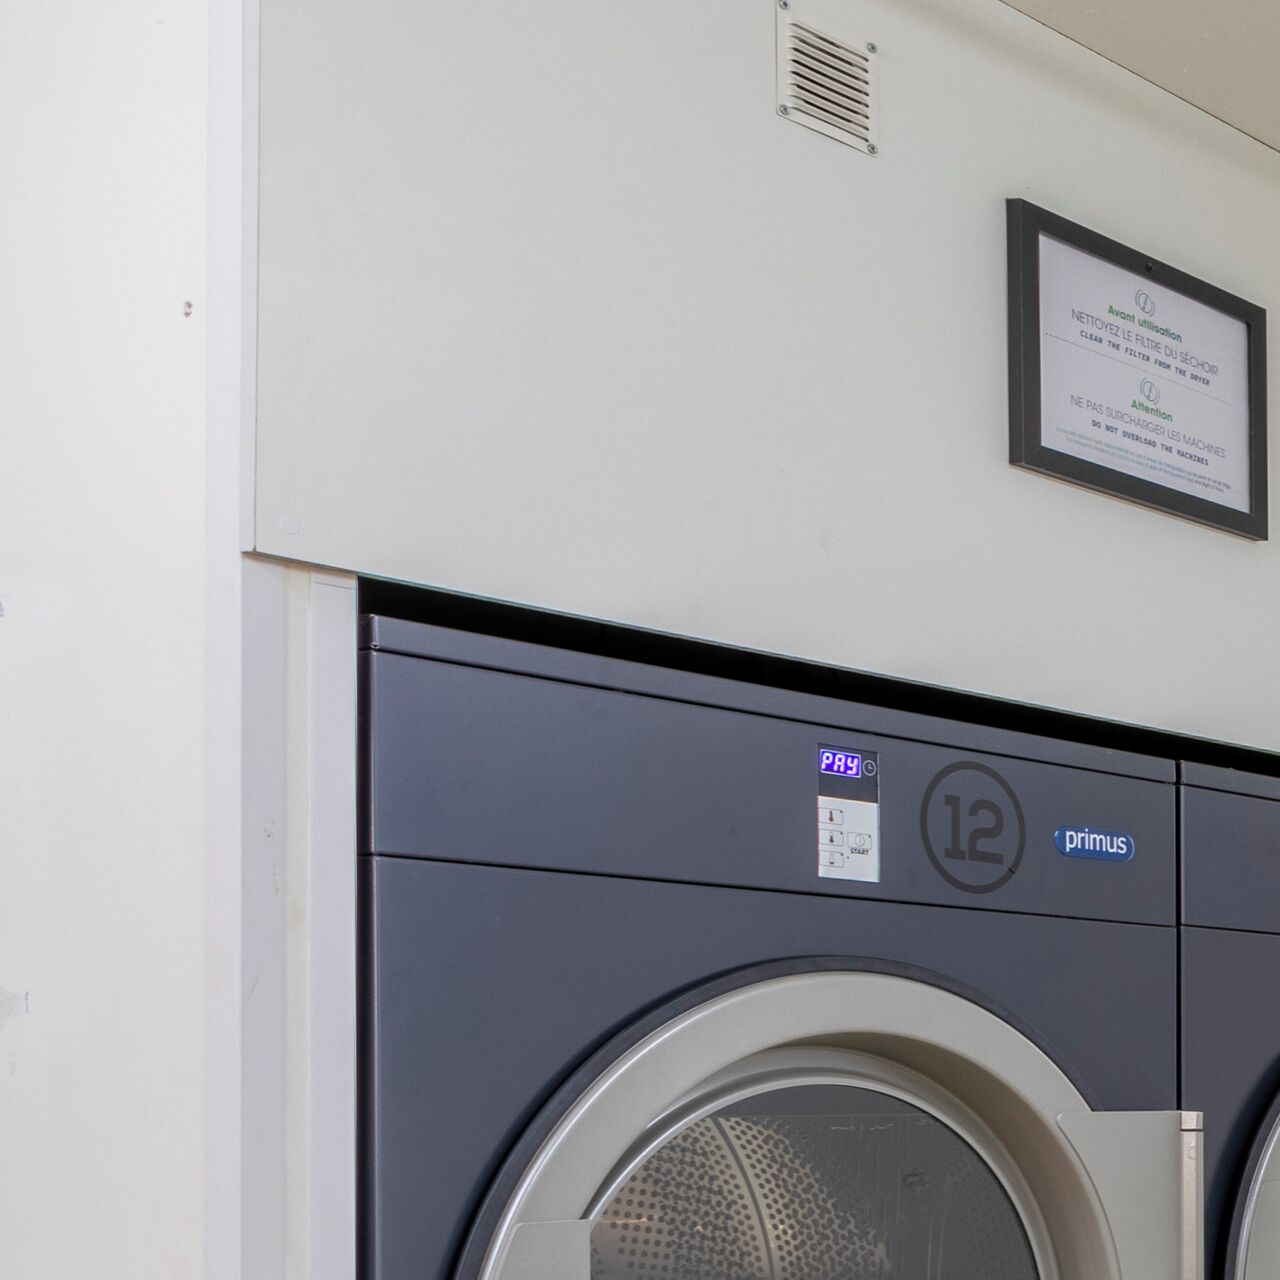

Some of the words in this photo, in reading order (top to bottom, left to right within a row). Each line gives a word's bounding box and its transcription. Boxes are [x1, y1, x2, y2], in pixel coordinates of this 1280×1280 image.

[1071, 307, 1121, 338] NETTOYEZ
[1122, 328, 1134, 343] LE
[1135, 333, 1162, 354] FILTRE
[1164, 345, 1178, 360] DU
[1180, 350, 1218, 377] SÉCHOIR
[1107, 304, 1136, 324] Avant
[1138, 318, 1182, 343] utilisation
[1080, 329, 1103, 344] CLEAN
[1107, 339, 1121, 352] THE
[1125, 346, 1151, 362] FILTER
[1154, 358, 1171, 371] FROM
[1174, 366, 1187, 377] THE
[1190, 372, 1210, 386] DRYER
[1070, 393, 1084, 409] NE
[1086, 399, 1104, 415] PAS
[1105, 406, 1166, 437] SURCHARGER
[1167, 427, 1181, 442] LES
[1183, 433, 1226, 459] MACHINES
[1131, 399, 1173, 422] Attention
[1091, 419, 1102, 429] DO
[1105, 423, 1118, 434] NOT
[1122, 430, 1157, 448] OVERLOAD
[1160, 442, 1173, 454] THE
[1176, 448, 1209, 466] MACHINES
[944, 794, 1004, 865] 12
[1065, 828, 1127, 854] primus
